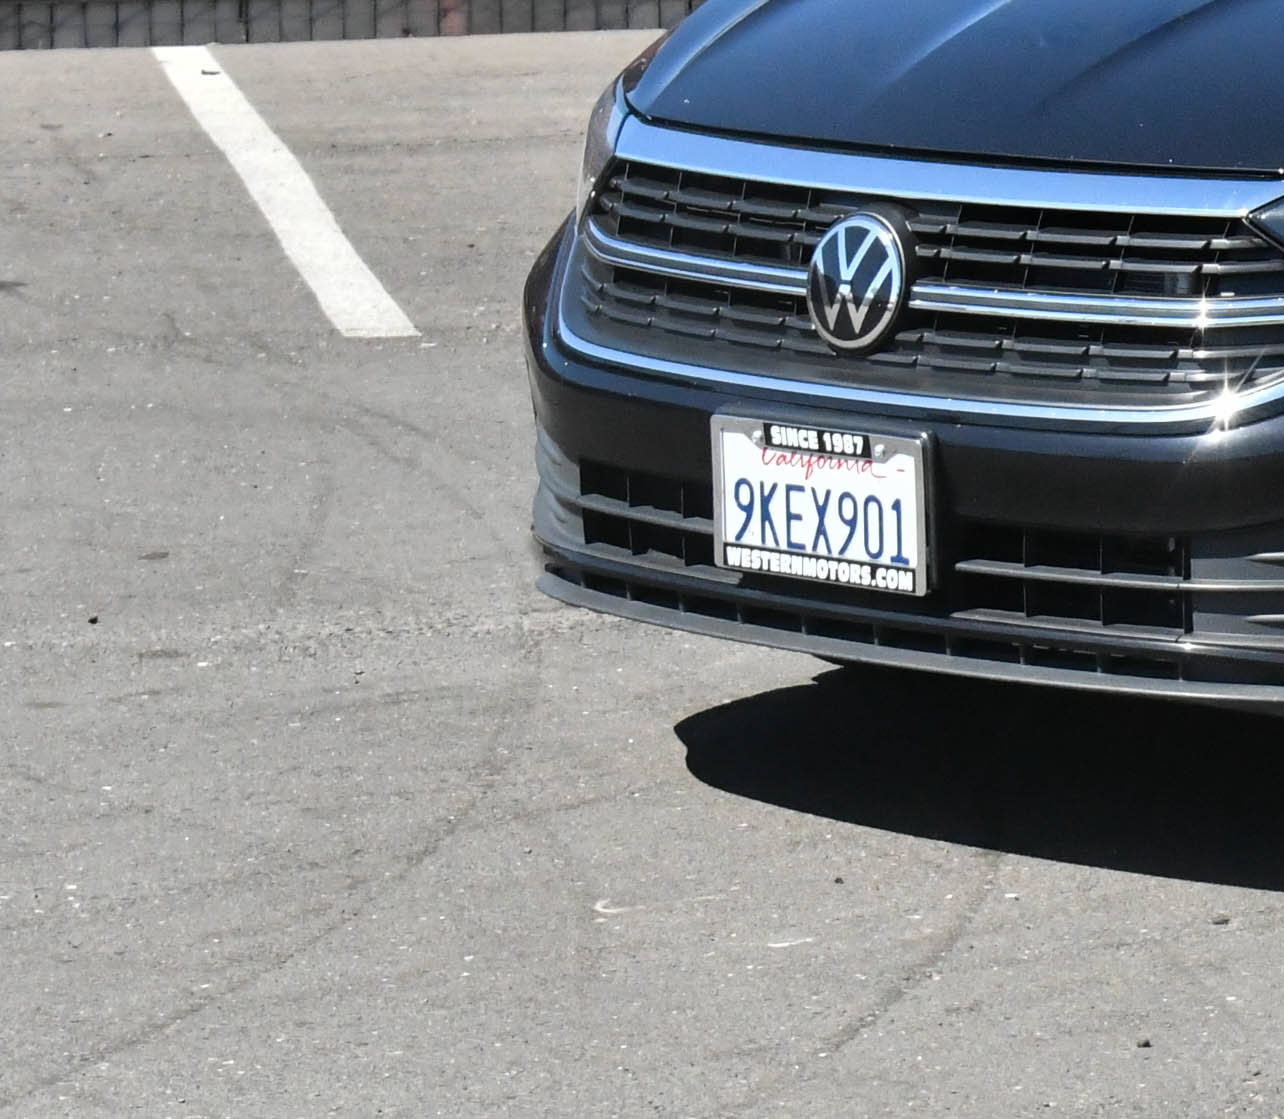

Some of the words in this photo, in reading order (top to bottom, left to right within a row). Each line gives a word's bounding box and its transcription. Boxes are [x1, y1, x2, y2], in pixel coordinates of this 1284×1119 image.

[769, 425, 819, 450] SINCE
[822, 432, 864, 455] 1987
[733, 478, 910, 566] 9KEX901
[726, 545, 914, 592] WESTERNMOTORS.COM
